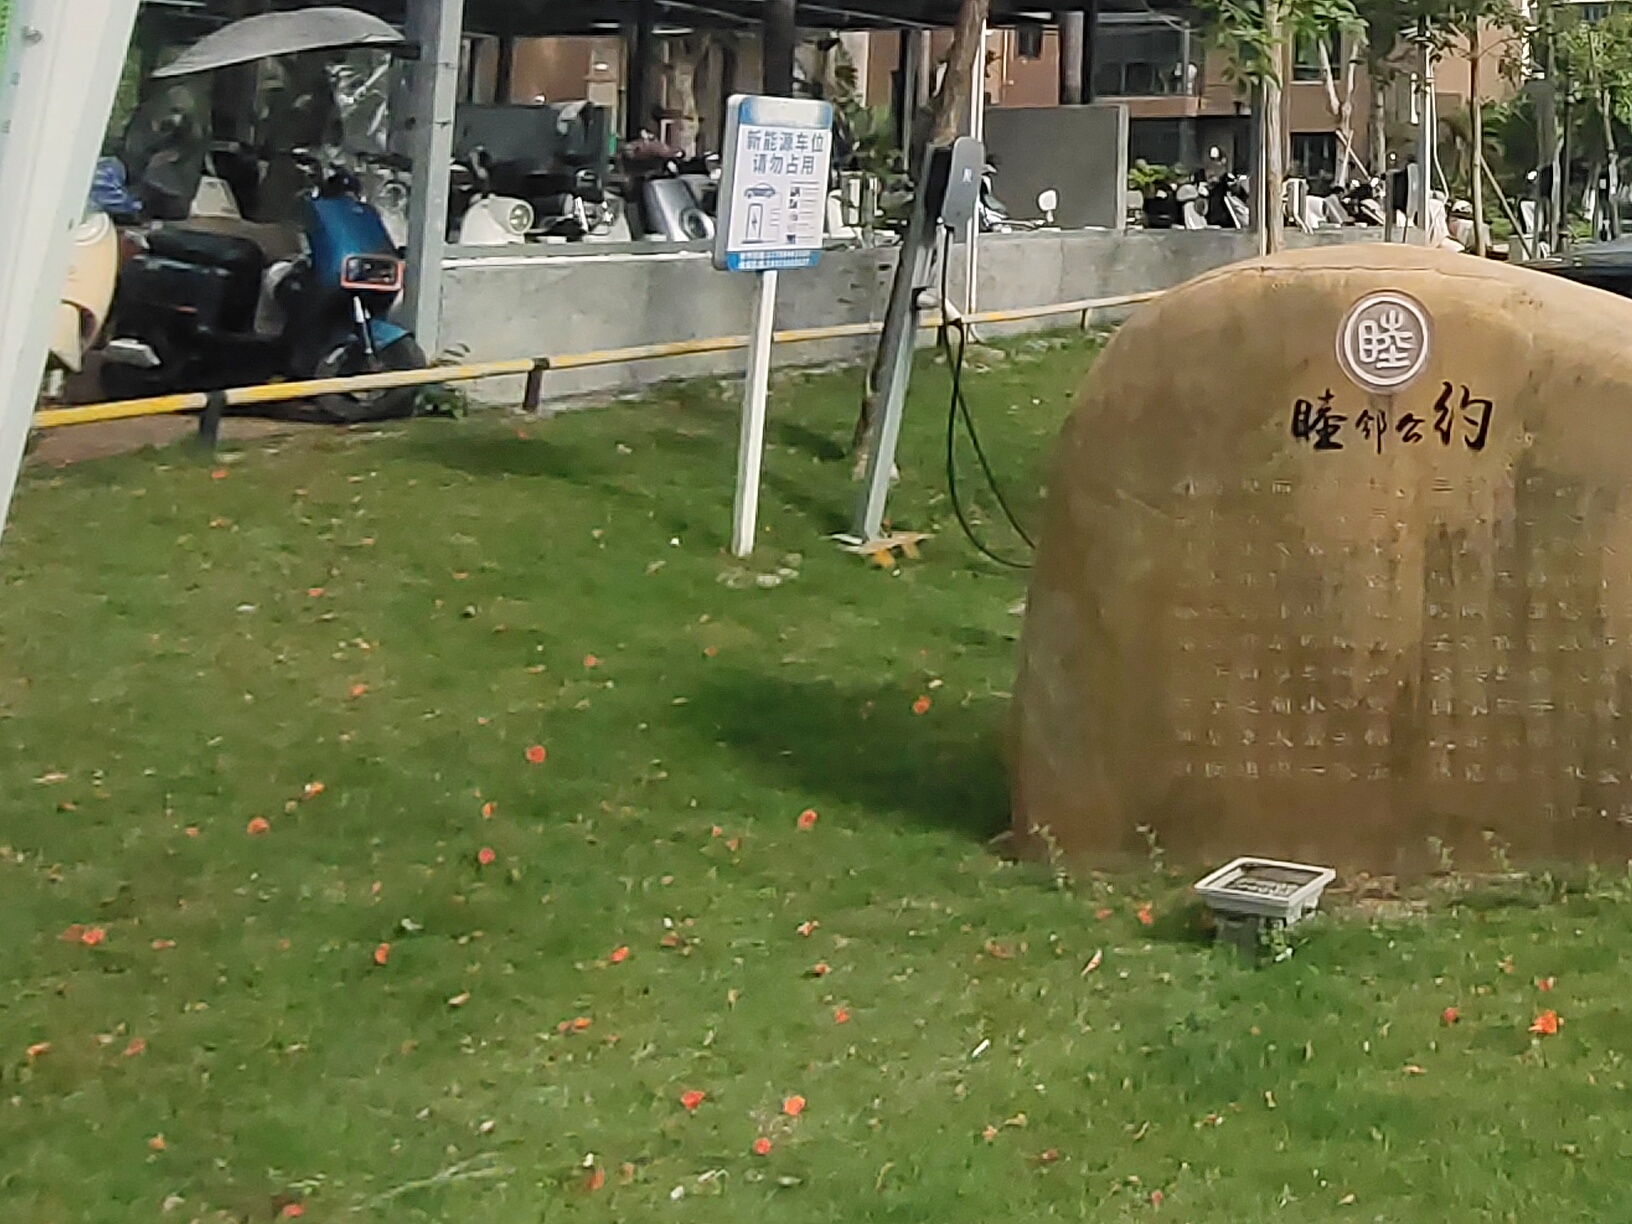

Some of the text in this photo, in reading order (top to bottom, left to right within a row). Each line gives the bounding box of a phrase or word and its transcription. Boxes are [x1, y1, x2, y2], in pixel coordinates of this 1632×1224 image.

[747, 130, 824, 153] 新能源车位
[753, 153, 815, 175] 请勿占用
[1291, 381, 1494, 455] 睦邻公约
